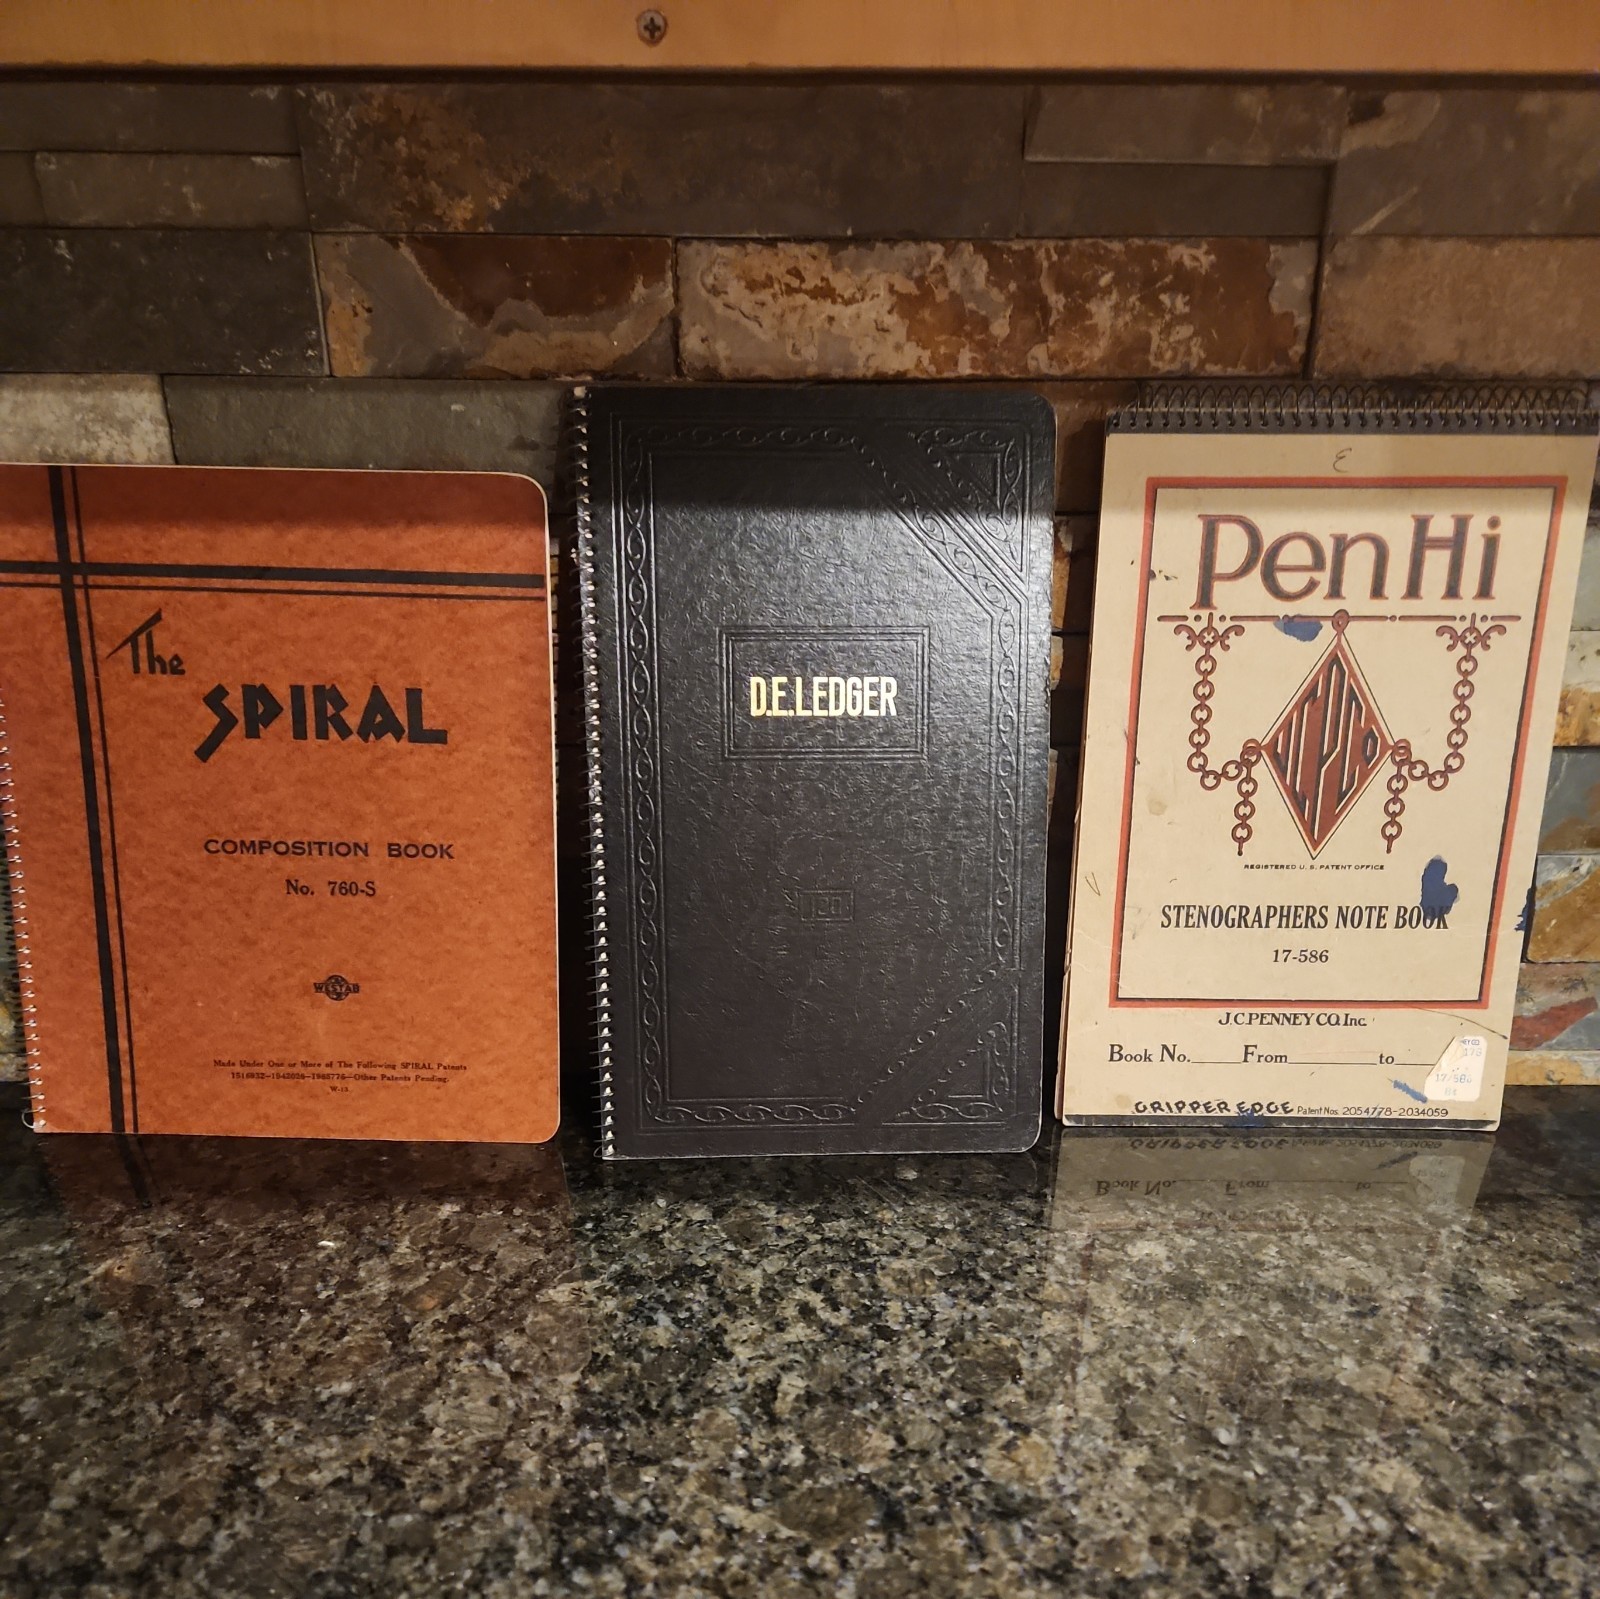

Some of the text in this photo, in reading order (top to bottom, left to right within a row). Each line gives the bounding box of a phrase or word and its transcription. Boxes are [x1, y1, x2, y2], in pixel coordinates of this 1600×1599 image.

[106, 608, 186, 675] The
[194, 683, 448, 763] SPIRAL
[203, 839, 454, 859] COMPOSITION BOOK
[286, 879, 376, 897] No. 760-S
[1160, 904, 1449, 930] STENOGRAPHERS NOTE BOOK
[1272, 949, 1329, 963] 17-586
[1108, 1044, 1395, 1065] Book No. From to
[213, 1060, 236, 1068] Made
[239, 1060, 264, 1068] Under
[267, 1060, 285, 1068] One
[337, 1061, 353, 1069] The
[356, 1061, 397, 1070] Following
[400, 1062, 434, 1070] SPIRAL
[437, 1063, 467, 1071] Patents
[380, 1073, 411, 1082] Patents
[1134, 1100, 1231, 1114] GRIPPER
[1236, 1101, 1294, 1115] EDGE
[1343, 1107, 1449, 1117] 2054778-2034059
